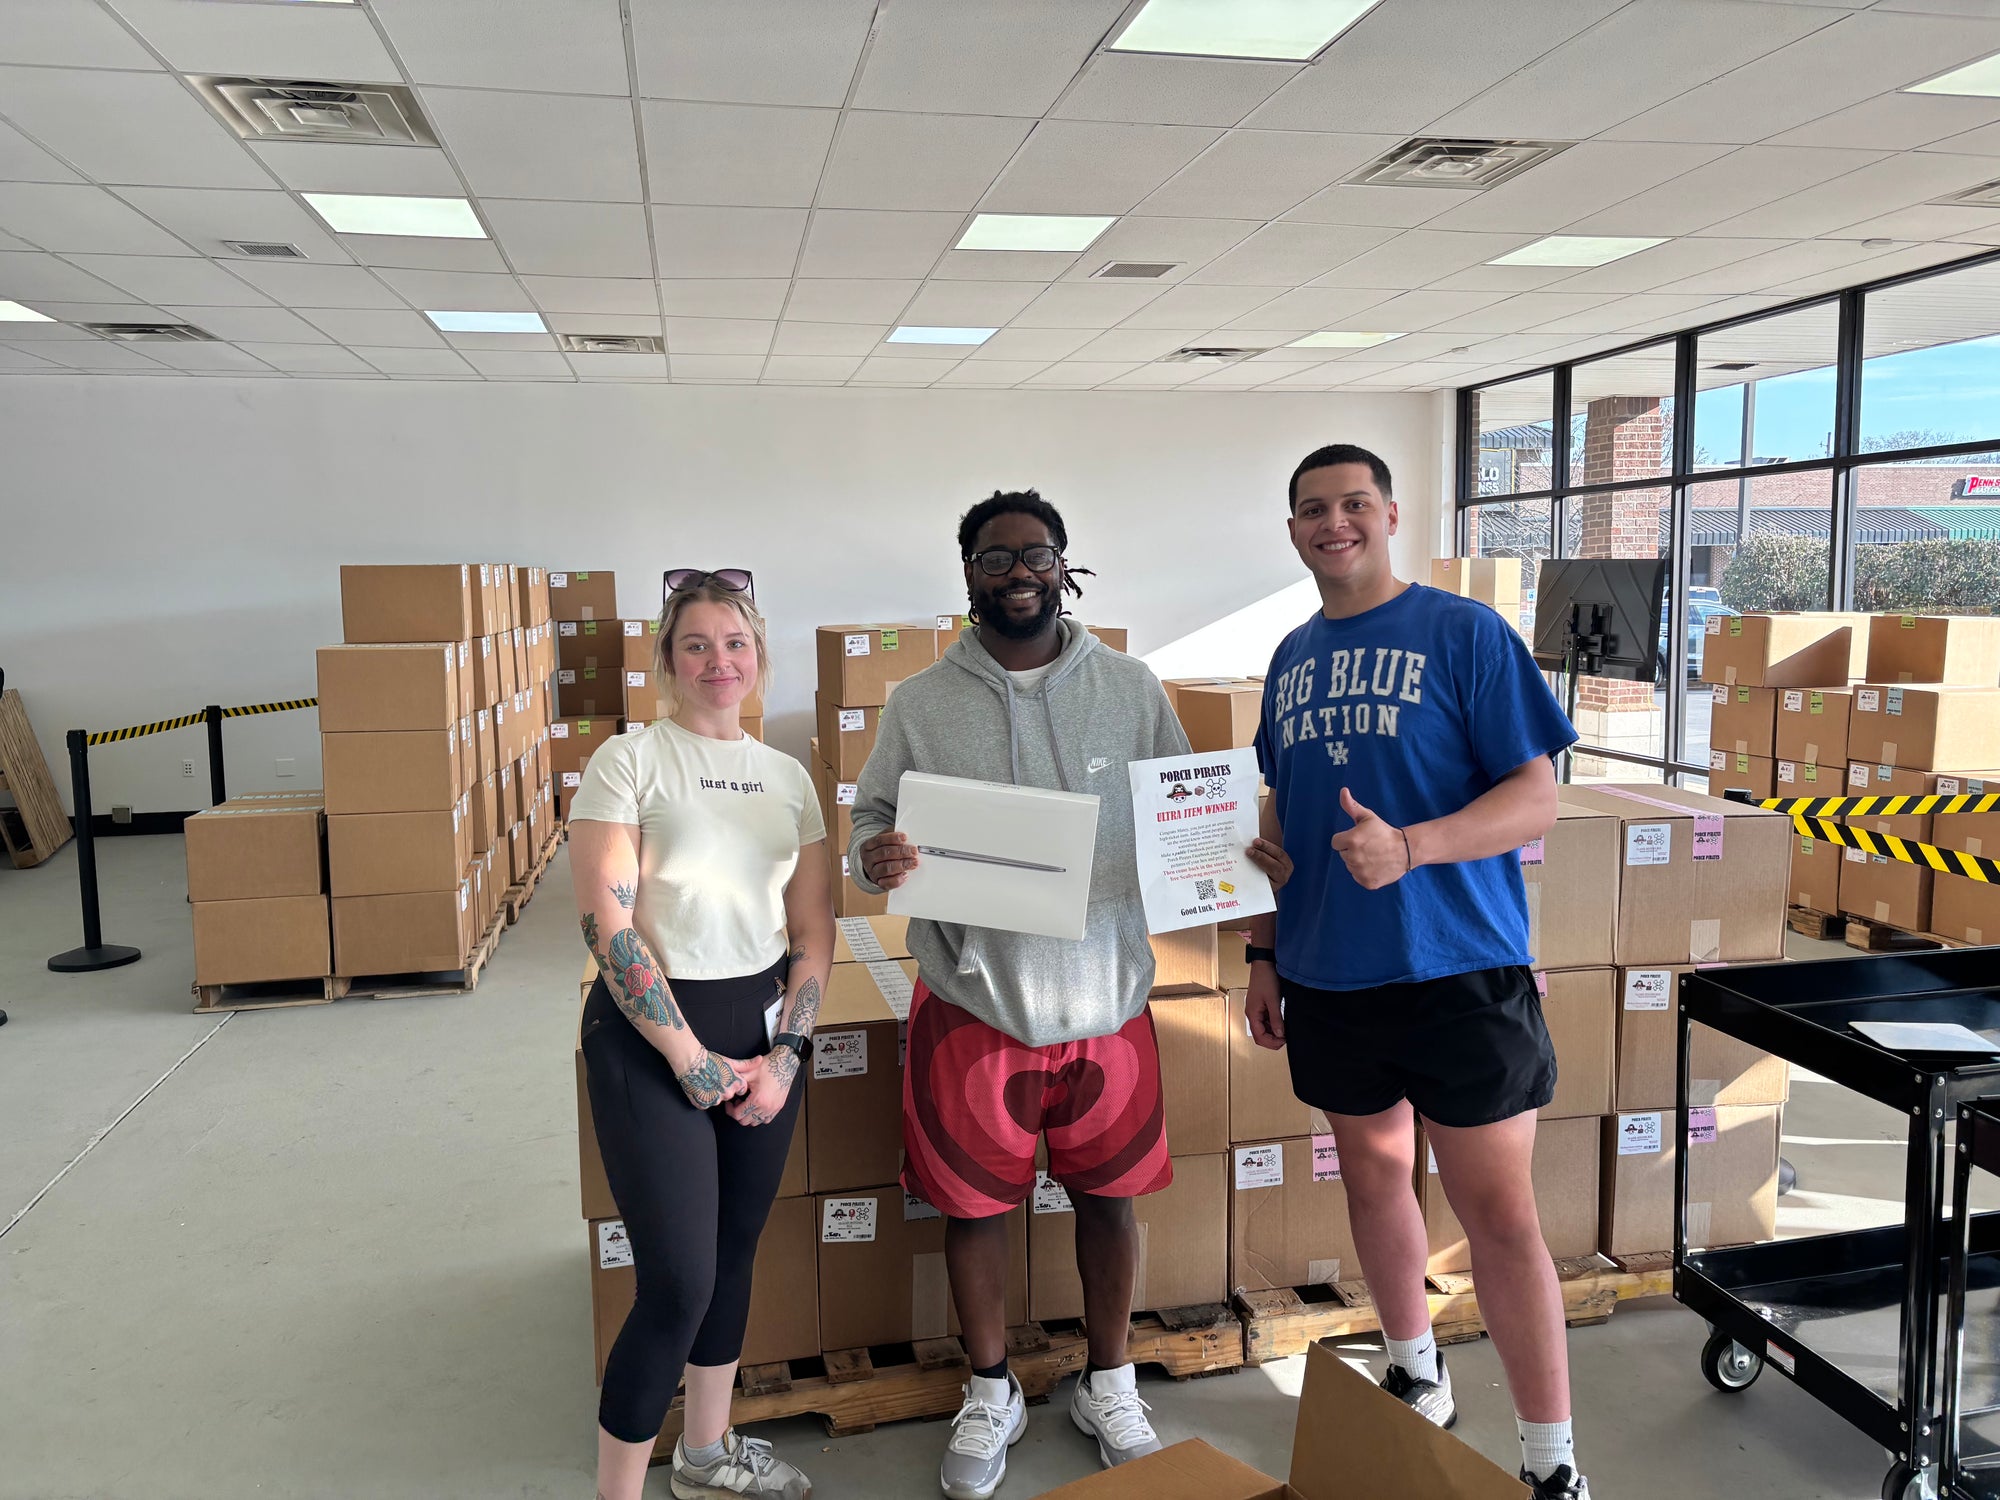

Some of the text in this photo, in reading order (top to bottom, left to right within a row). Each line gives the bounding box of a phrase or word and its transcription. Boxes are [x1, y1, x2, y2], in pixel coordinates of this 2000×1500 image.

[1968, 477, 1994, 493] PENN
[1275, 647, 1427, 723] BIG BLUE
[1282, 703, 1400, 749] NATION
[1090, 757, 1108, 767] NIKE
[1326, 740, 1349, 766] UK
[1160, 764, 1232, 783] PORCH PIRATES
[700, 777, 764, 794] just a girl
[1156, 801, 1238, 822] ULTRA ITEM WINNER!
[1180, 899, 1240, 917] Good Luck, Pirates.
